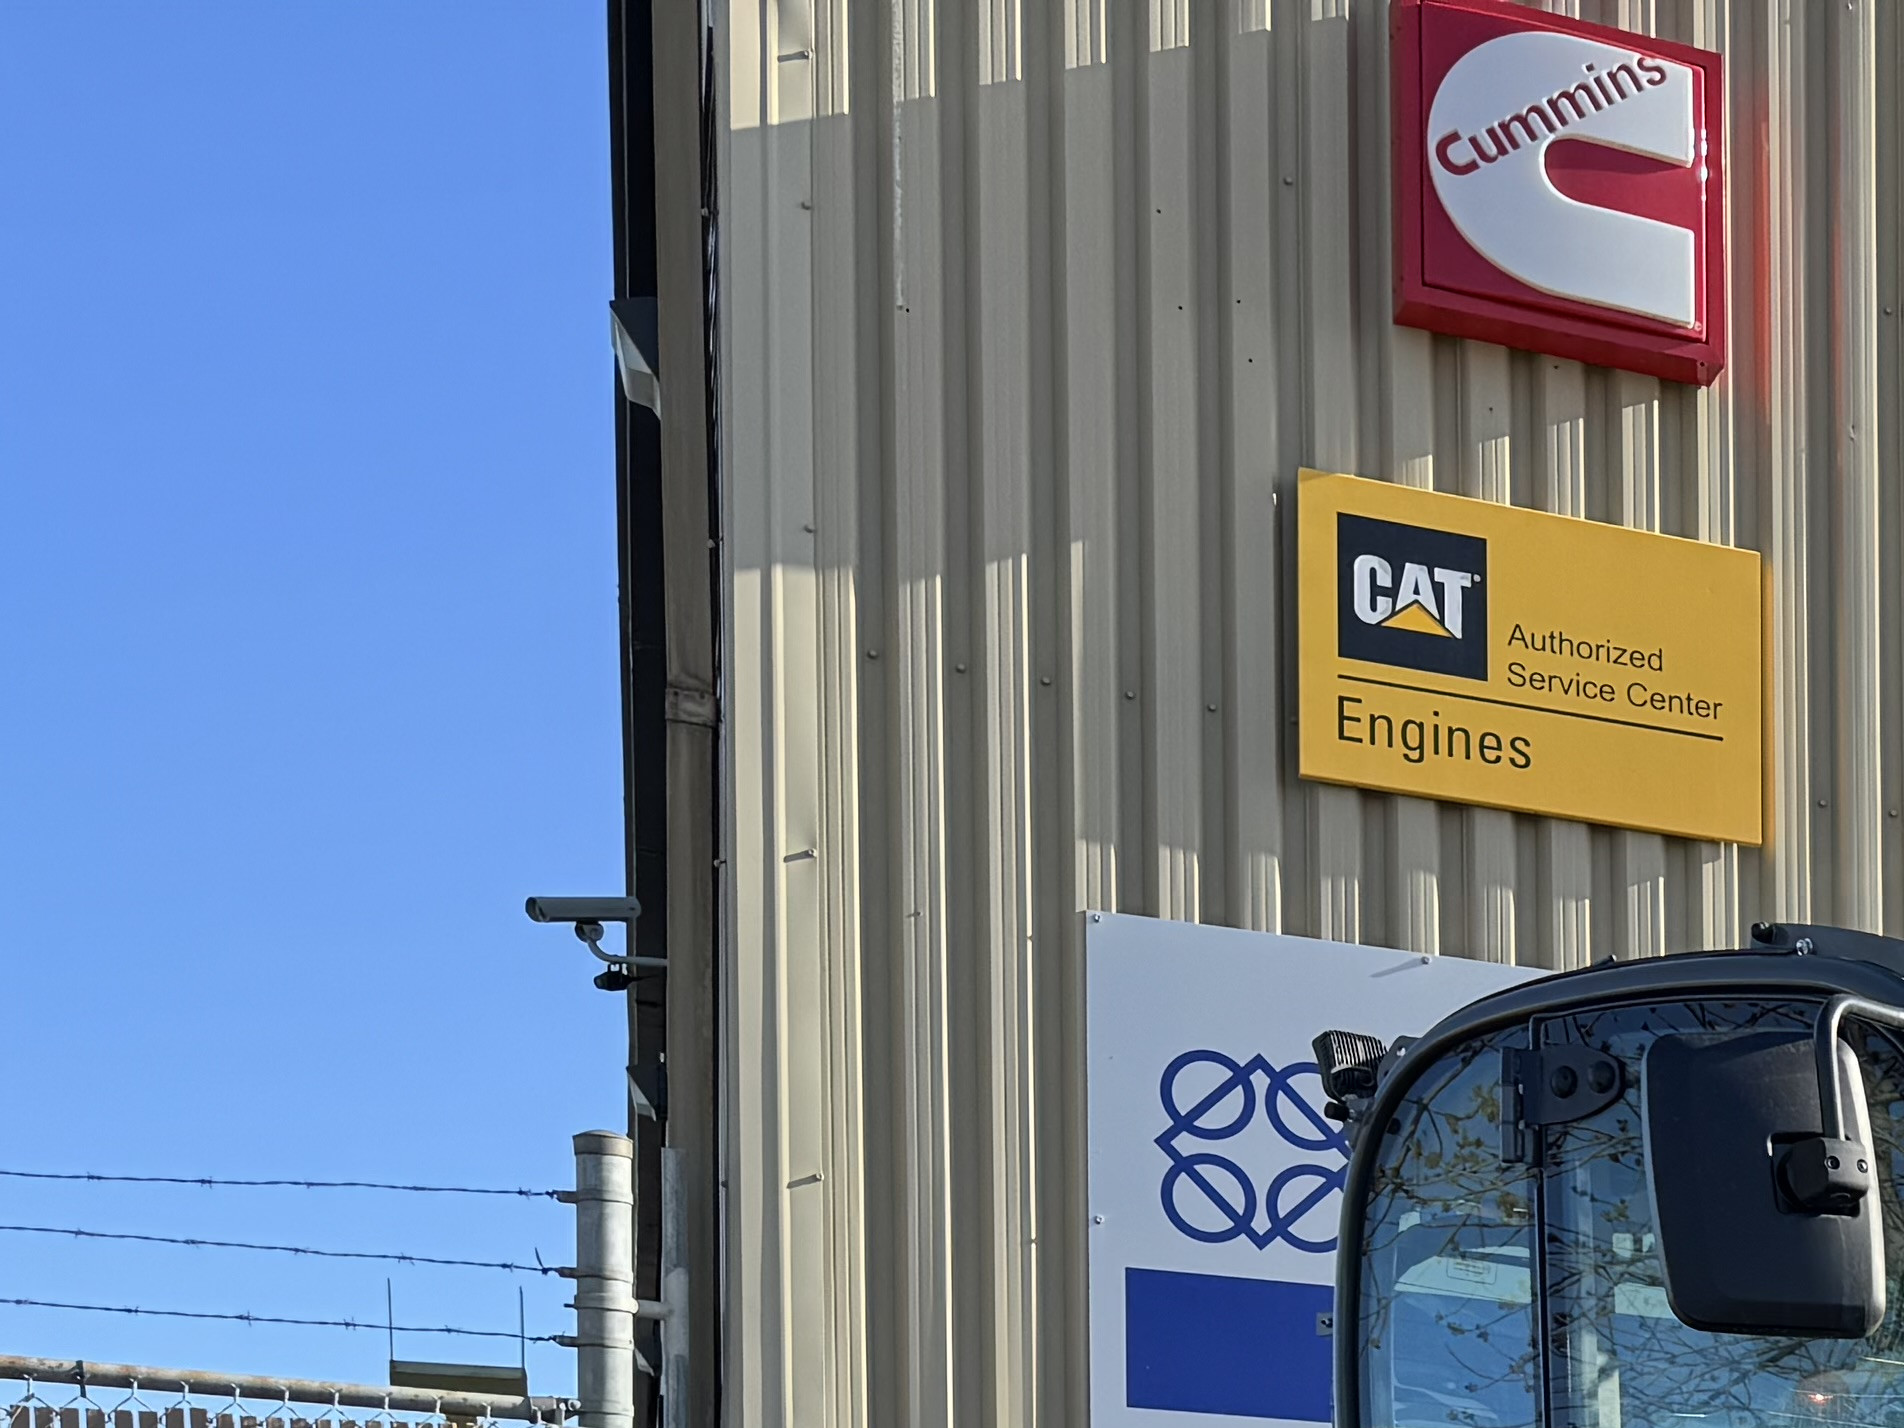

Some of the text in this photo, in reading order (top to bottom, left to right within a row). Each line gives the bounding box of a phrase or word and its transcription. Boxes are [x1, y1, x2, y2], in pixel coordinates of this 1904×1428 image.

[1435, 55, 1668, 177] Cummins
[1352, 553, 1472, 640] CAT
[1507, 622, 1664, 673] Authorized
[1507, 662, 1724, 722] Service Center
[1337, 696, 1533, 770] Engines
